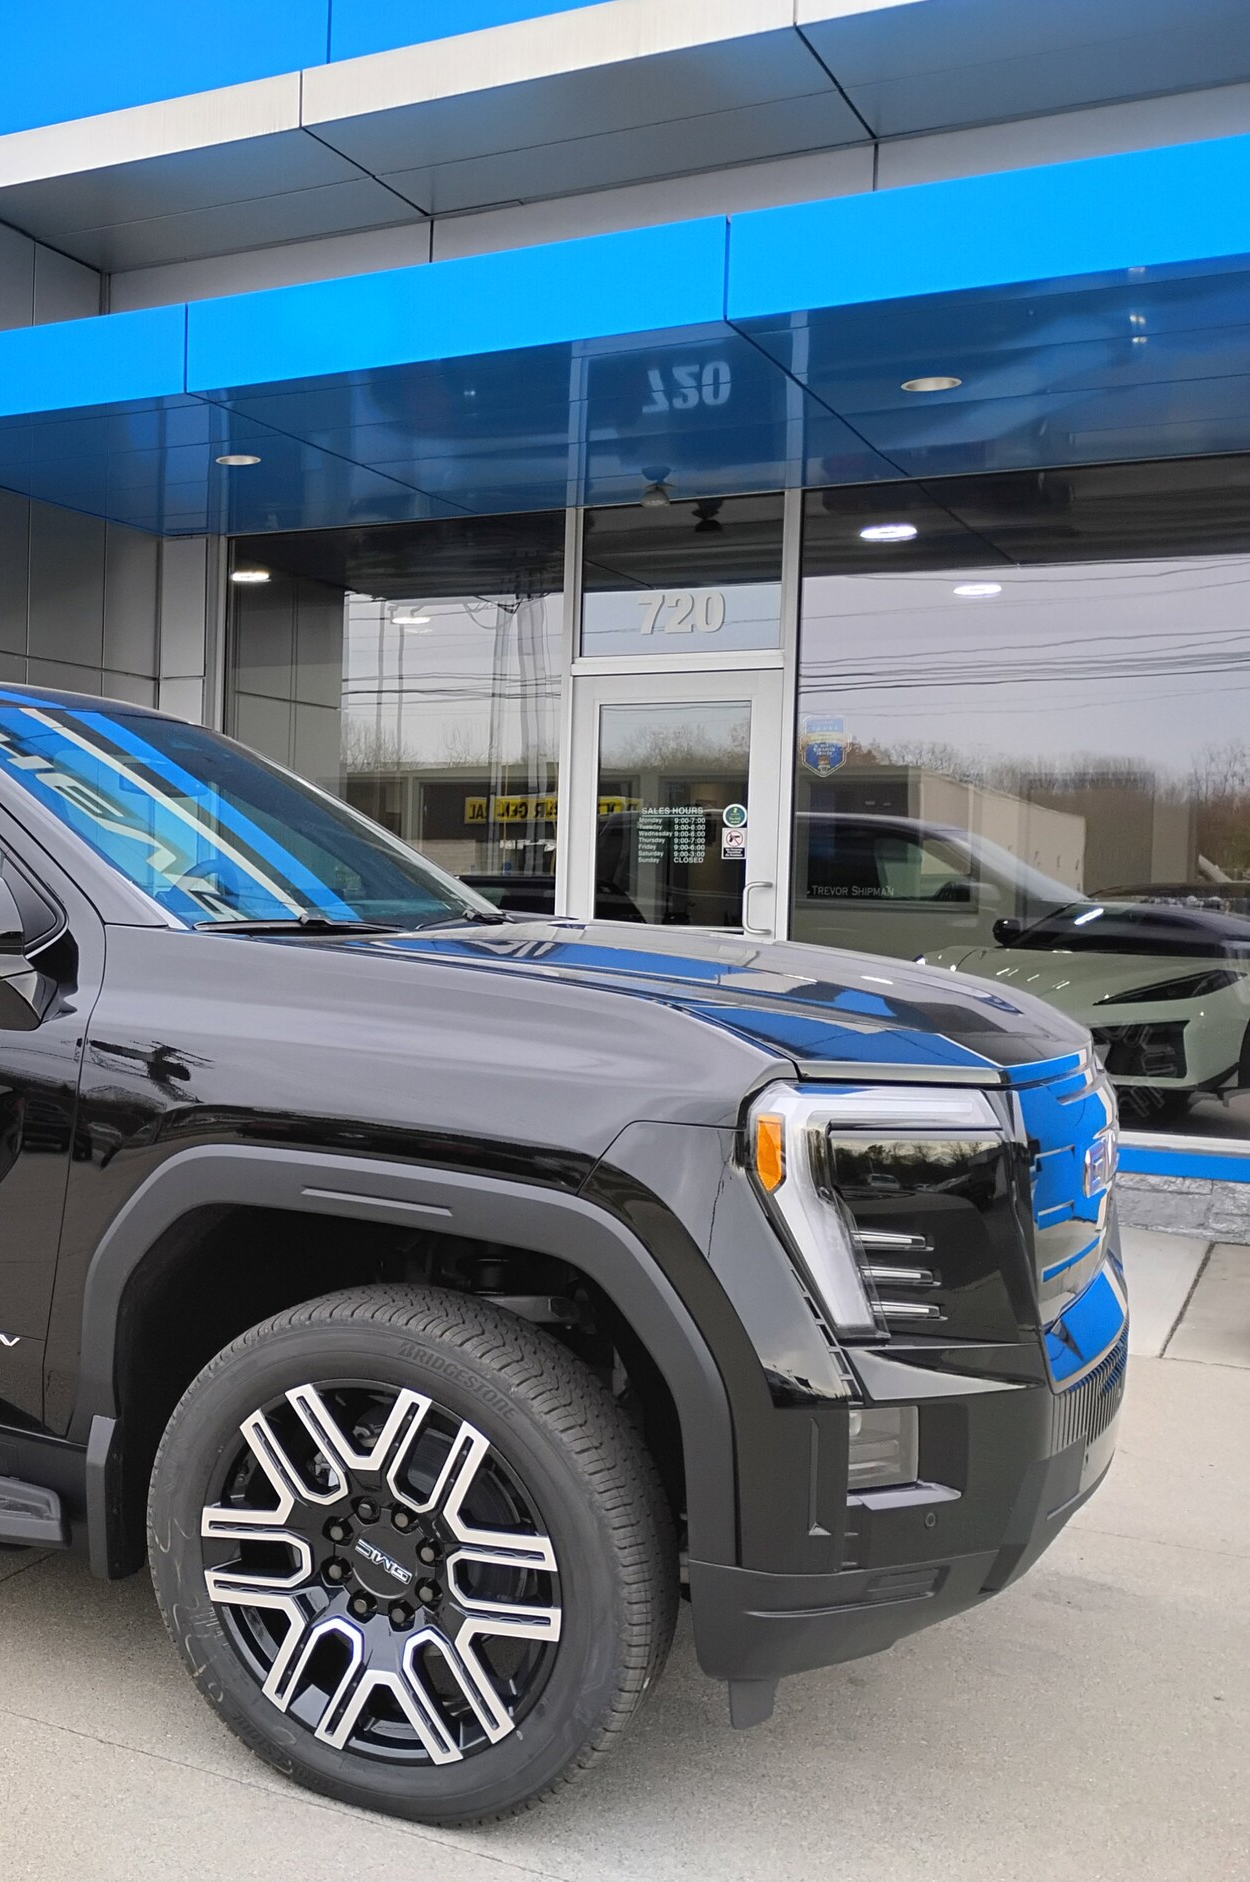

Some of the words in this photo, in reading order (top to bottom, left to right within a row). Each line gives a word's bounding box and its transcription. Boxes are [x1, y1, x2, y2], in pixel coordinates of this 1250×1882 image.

[638, 591, 726, 635] 720
[641, 807, 670, 815] SALES
[672, 806, 704, 815] HOURS
[811, 885, 849, 897] TREVOR
[851, 885, 895, 897] SHIPMAN
[398, 1341, 519, 1420] BRIDGESTONE
[355, 1539, 413, 1585] GMC
